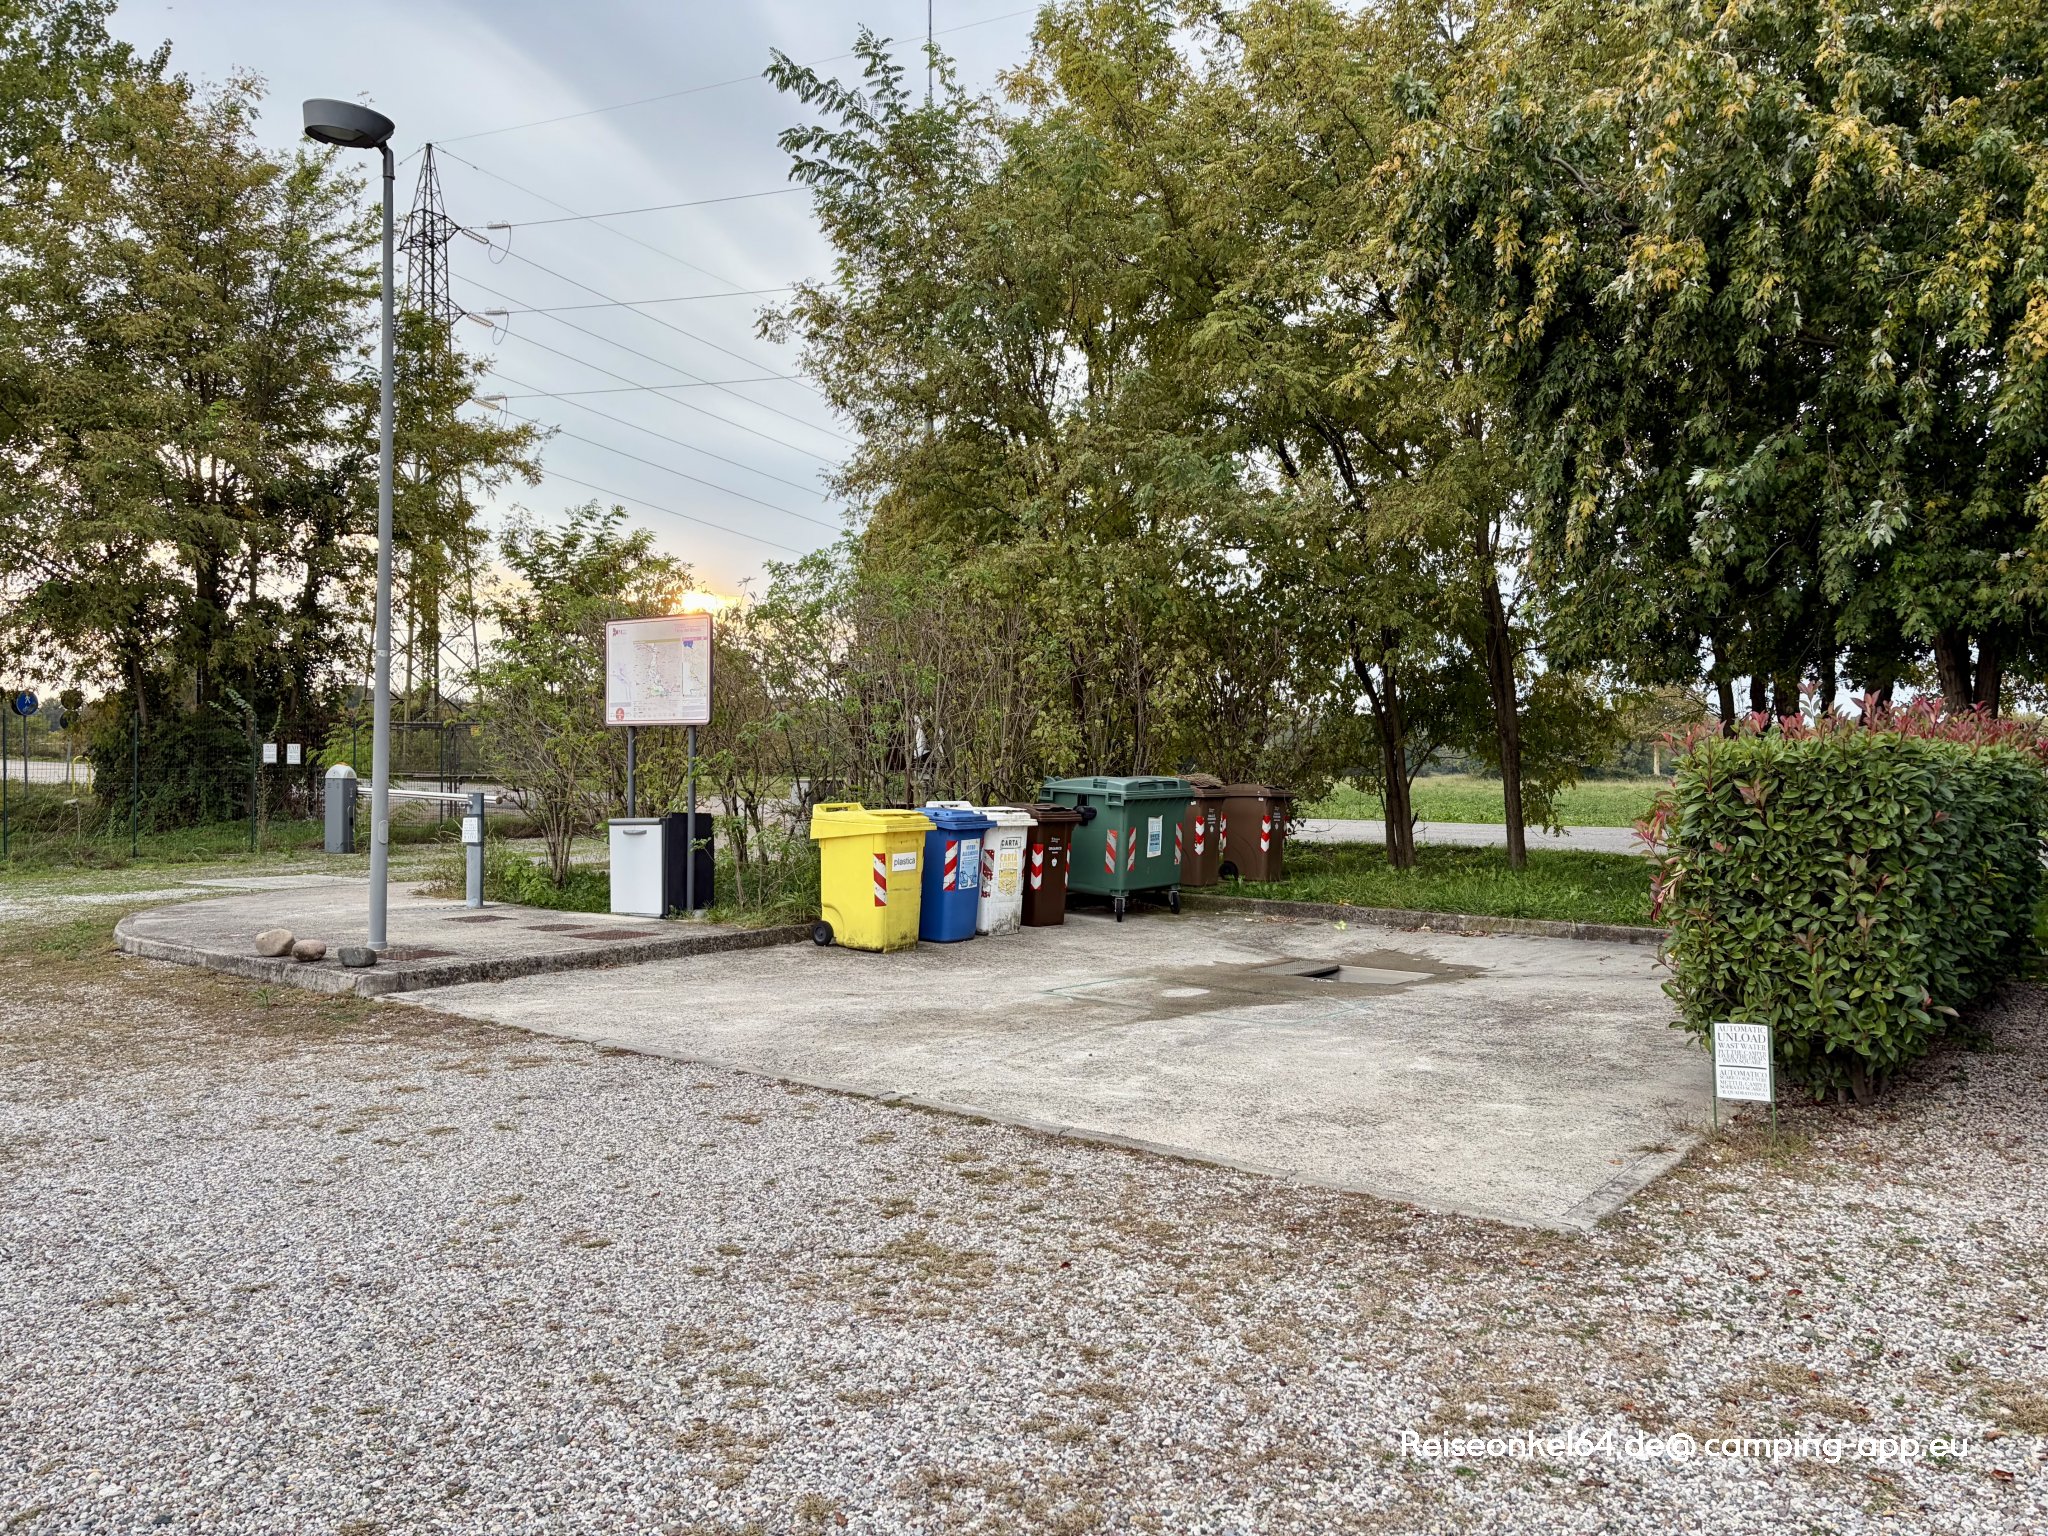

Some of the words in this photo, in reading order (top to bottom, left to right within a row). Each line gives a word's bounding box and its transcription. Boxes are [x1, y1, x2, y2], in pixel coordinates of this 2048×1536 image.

[1001, 839, 1019, 847] CARTA
[893, 857, 916, 868] plastica
[1718, 1025, 1766, 1034] AUTOMATIC
[1717, 1032, 1766, 1044] UNLOAD
[1740, 1043, 1767, 1051] WATER
[1720, 1069, 1768, 1078] AUTOMATICO
